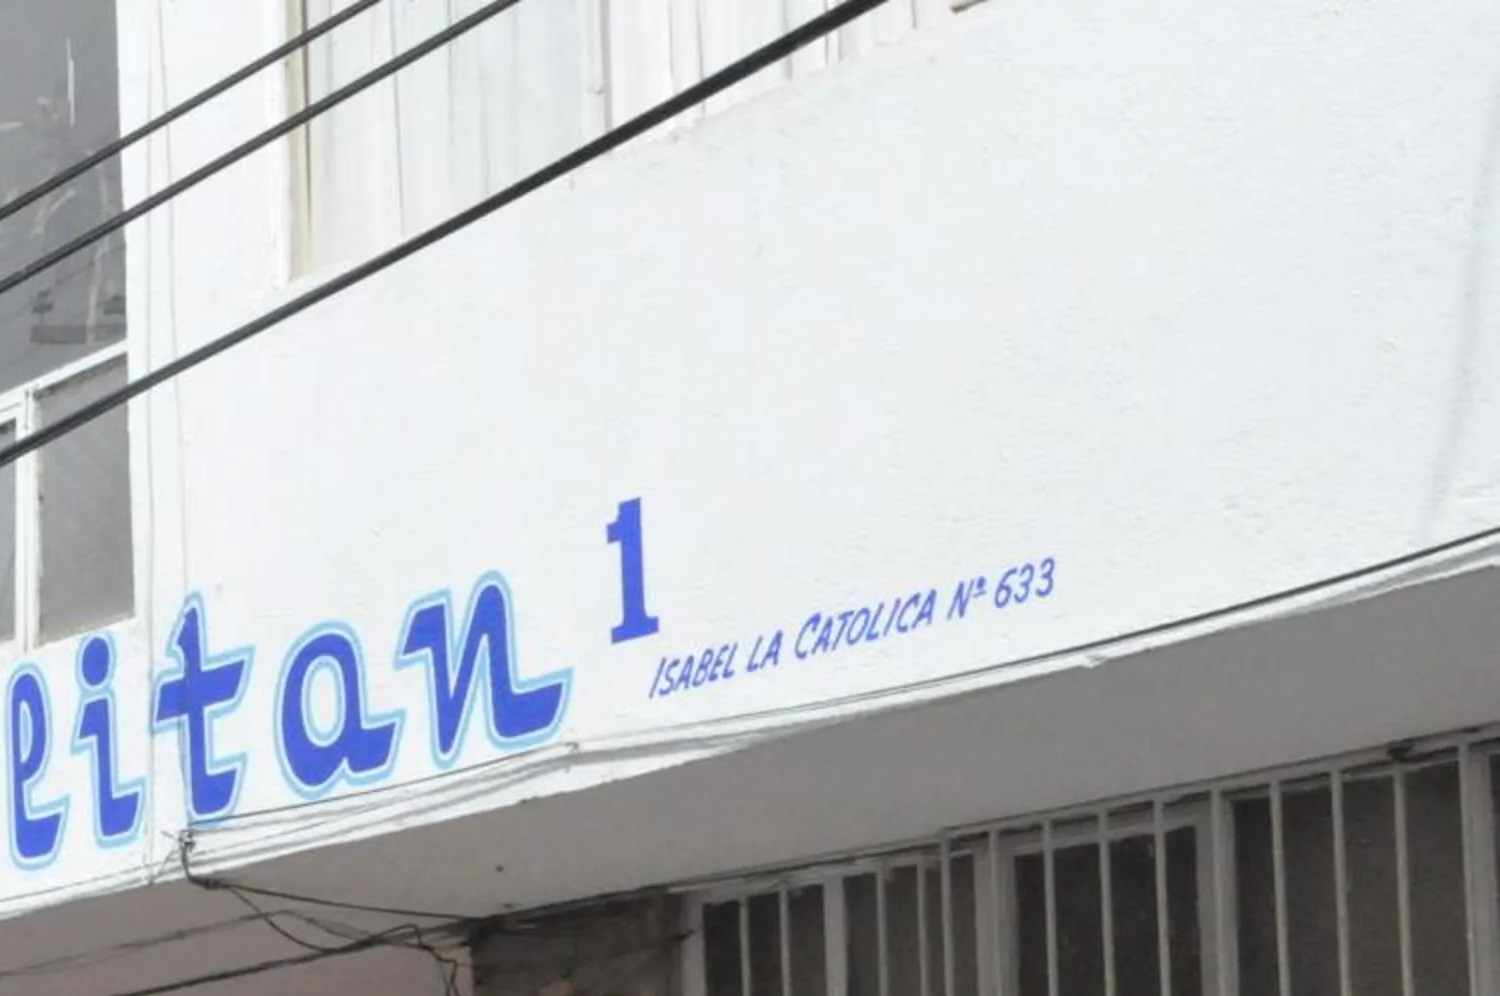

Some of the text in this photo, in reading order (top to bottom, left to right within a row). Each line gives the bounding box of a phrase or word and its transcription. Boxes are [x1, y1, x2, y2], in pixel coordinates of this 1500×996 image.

[605, 496, 660, 644] 1
[648, 643, 736, 699] ISABEL
[745, 630, 783, 673] LA
[794, 588, 937, 661] CATOLICA
[994, 556, 1056, 609] 633
